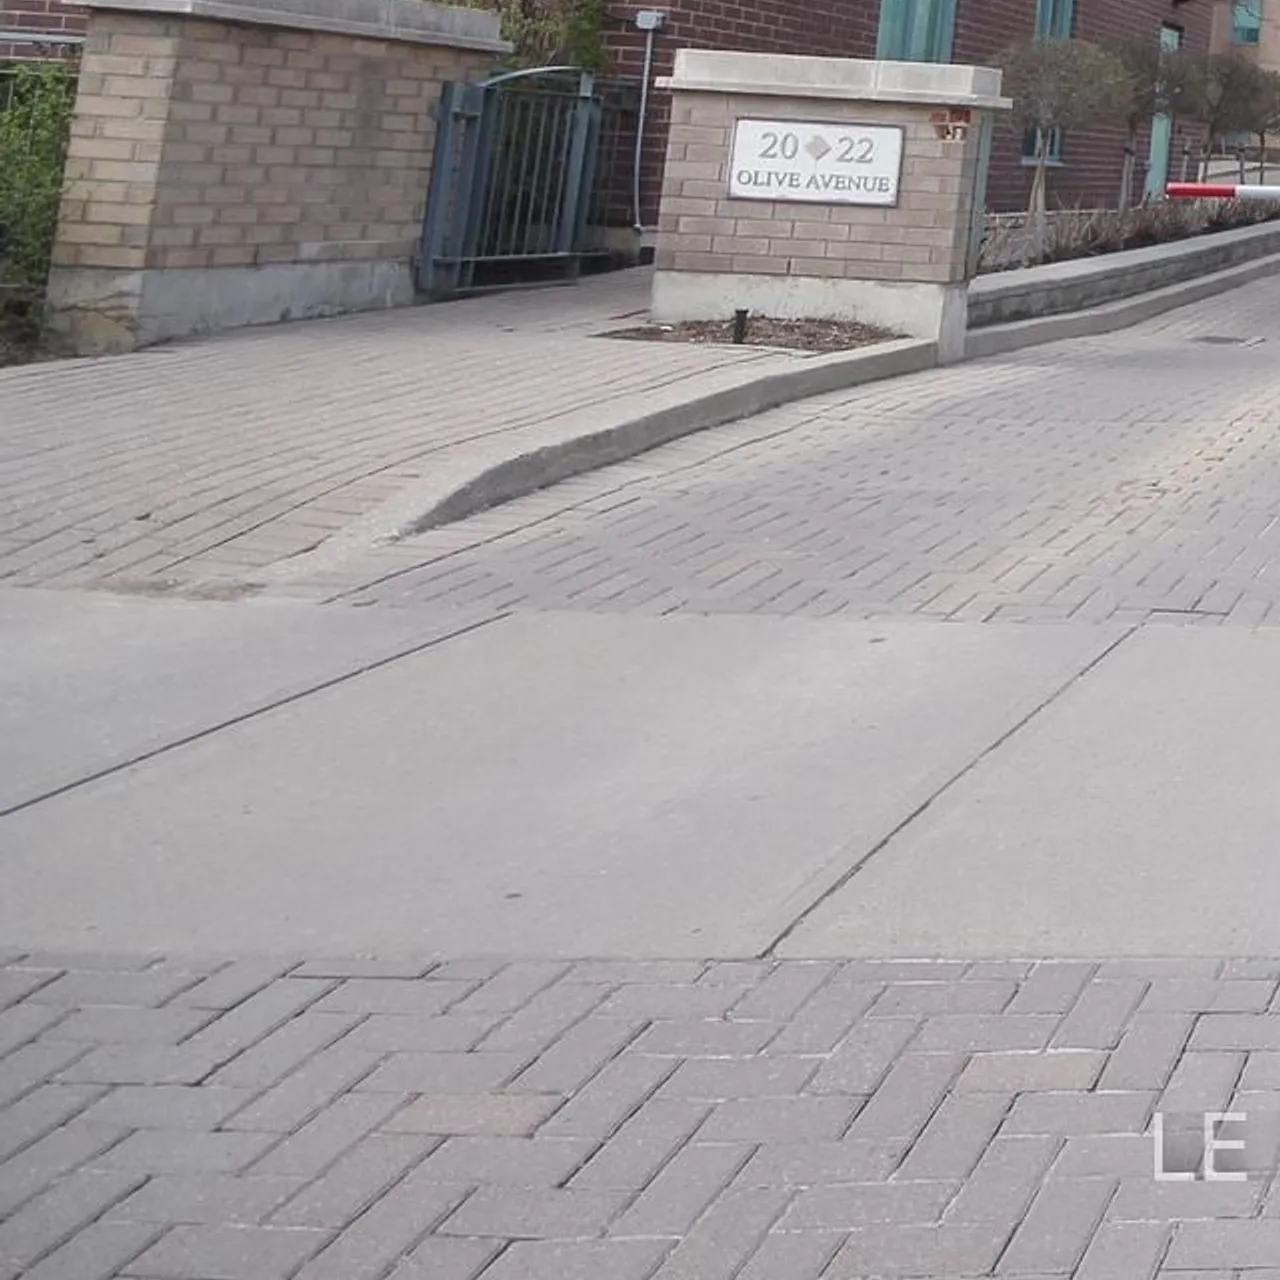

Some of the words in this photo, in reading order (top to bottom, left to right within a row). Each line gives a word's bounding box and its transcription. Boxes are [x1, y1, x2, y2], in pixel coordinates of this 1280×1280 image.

[758, 131, 799, 160] 20
[836, 136, 875, 164] 22
[736, 169, 801, 189] OLIVE
[805, 173, 891, 193] AVENUE
